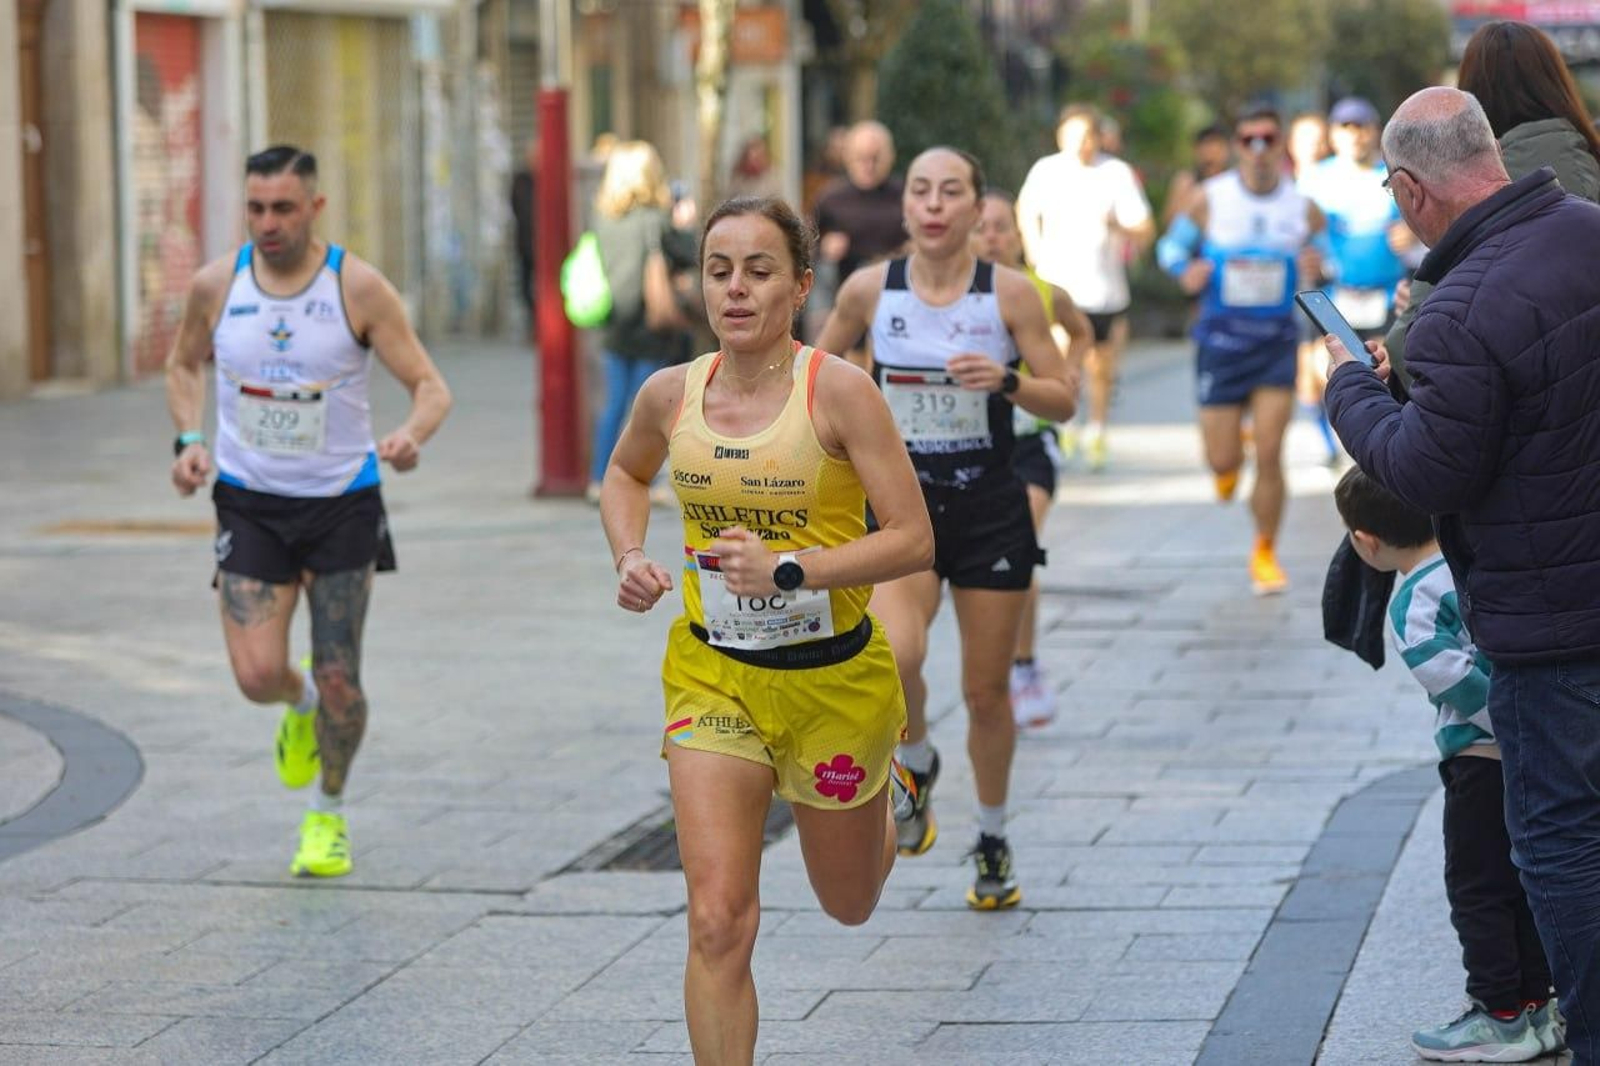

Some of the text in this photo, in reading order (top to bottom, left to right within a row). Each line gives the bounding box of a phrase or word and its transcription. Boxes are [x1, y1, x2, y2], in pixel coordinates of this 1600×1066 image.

[912, 392, 956, 413] 319
[259, 408, 299, 430] 209
[740, 476, 805, 488] San Lázaro
[683, 501, 807, 528] ATHLETICS
[700, 521, 731, 540] Sa
